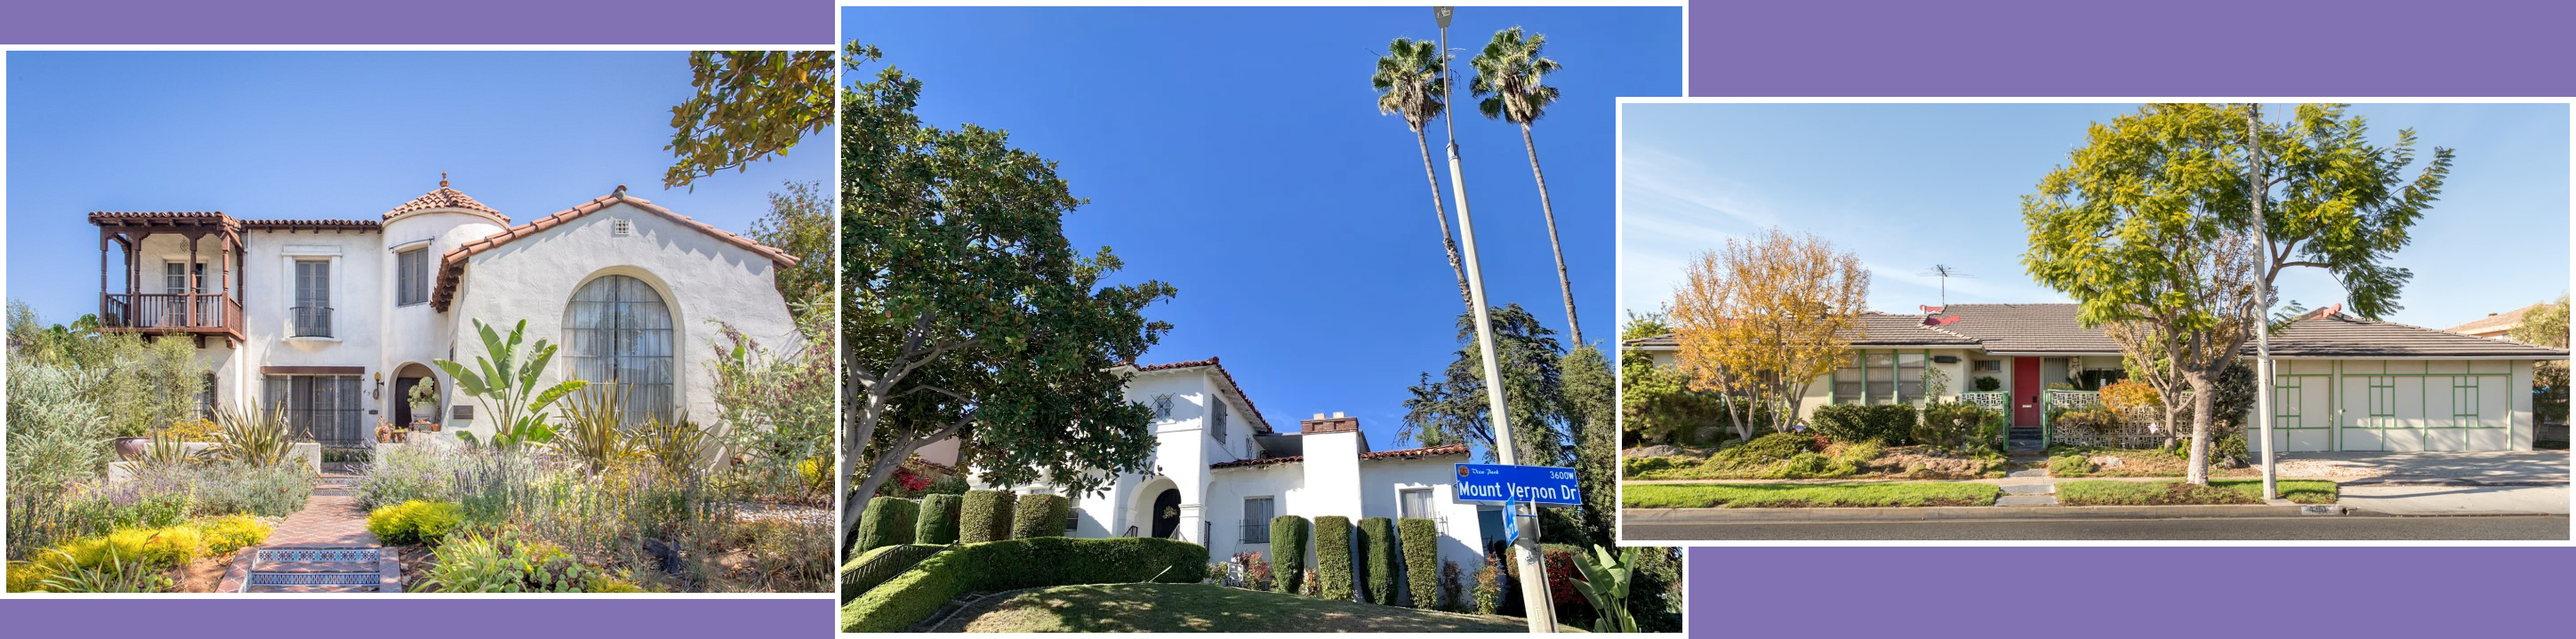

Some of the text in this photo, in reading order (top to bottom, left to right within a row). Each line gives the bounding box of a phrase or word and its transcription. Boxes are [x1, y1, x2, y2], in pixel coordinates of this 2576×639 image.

[1550, 470, 1574, 480] 3600W
[1459, 481, 1577, 500] Mount Vernon Dr
